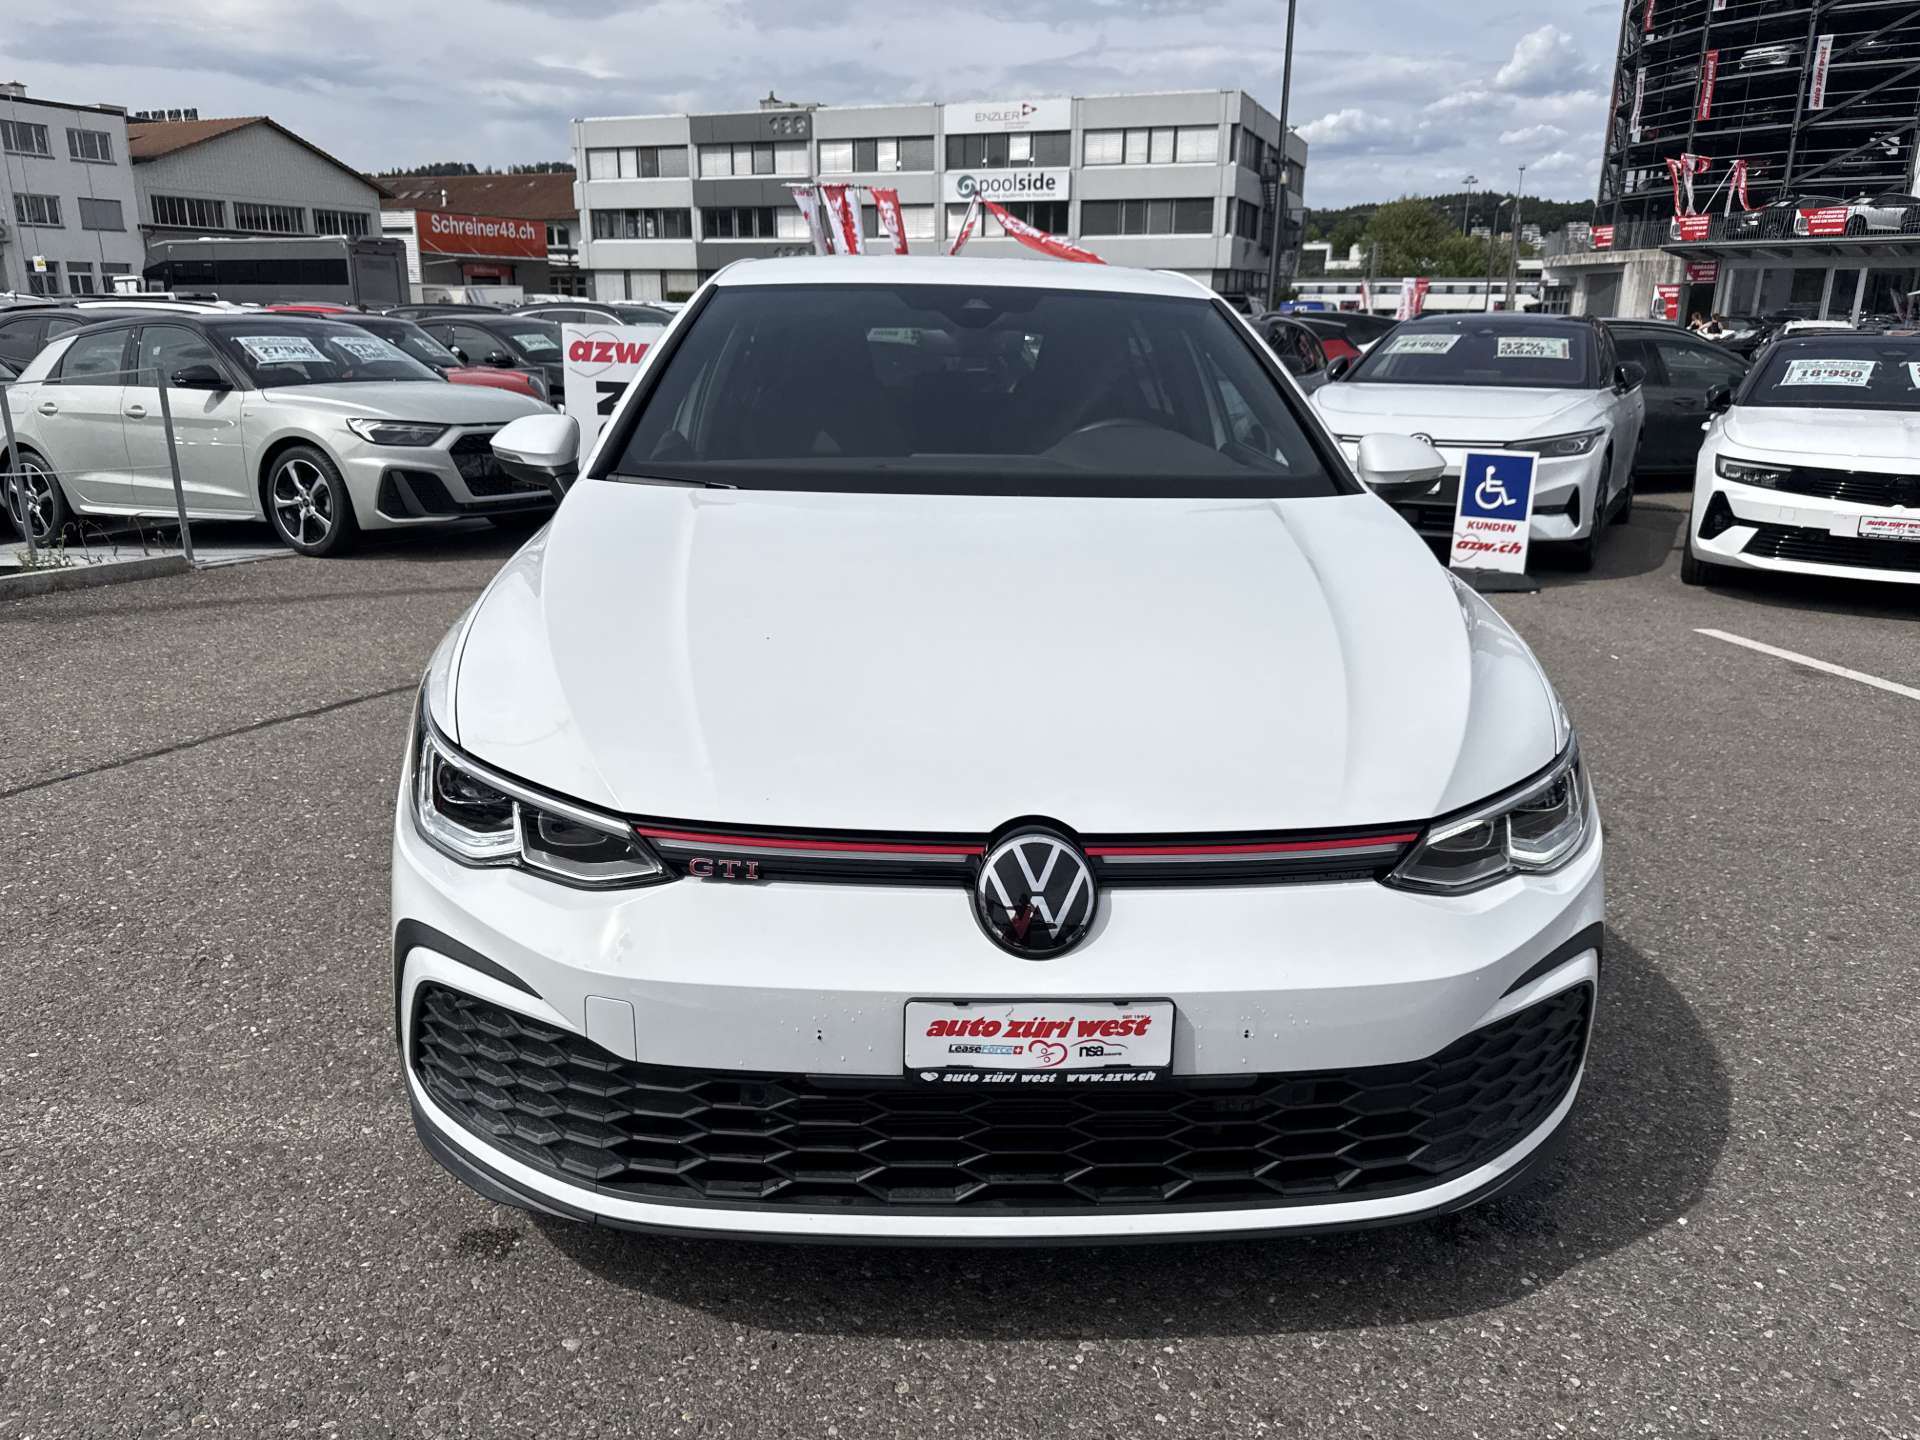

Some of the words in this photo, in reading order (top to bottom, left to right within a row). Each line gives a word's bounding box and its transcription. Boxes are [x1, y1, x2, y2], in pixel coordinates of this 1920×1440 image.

[975, 111, 1020, 122] ENZLER
[979, 172, 1056, 194] poolside
[431, 214, 536, 240] Schreiner48.ch
[1466, 521, 1517, 533] KUNDEN
[1456, 540, 1522, 555] azw.ch
[689, 857, 759, 880] GTI
[926, 1016, 1002, 1038] auto
[1002, 1016, 1076, 1038] züri
[1077, 1016, 1153, 1038] west
[1079, 1045, 1104, 1057] nsa
[942, 1073, 979, 1082] auto
[982, 1071, 1018, 1083] züri
[1020, 1072, 1057, 1082] west
[1066, 1070, 1157, 1083] www.azw.ch
